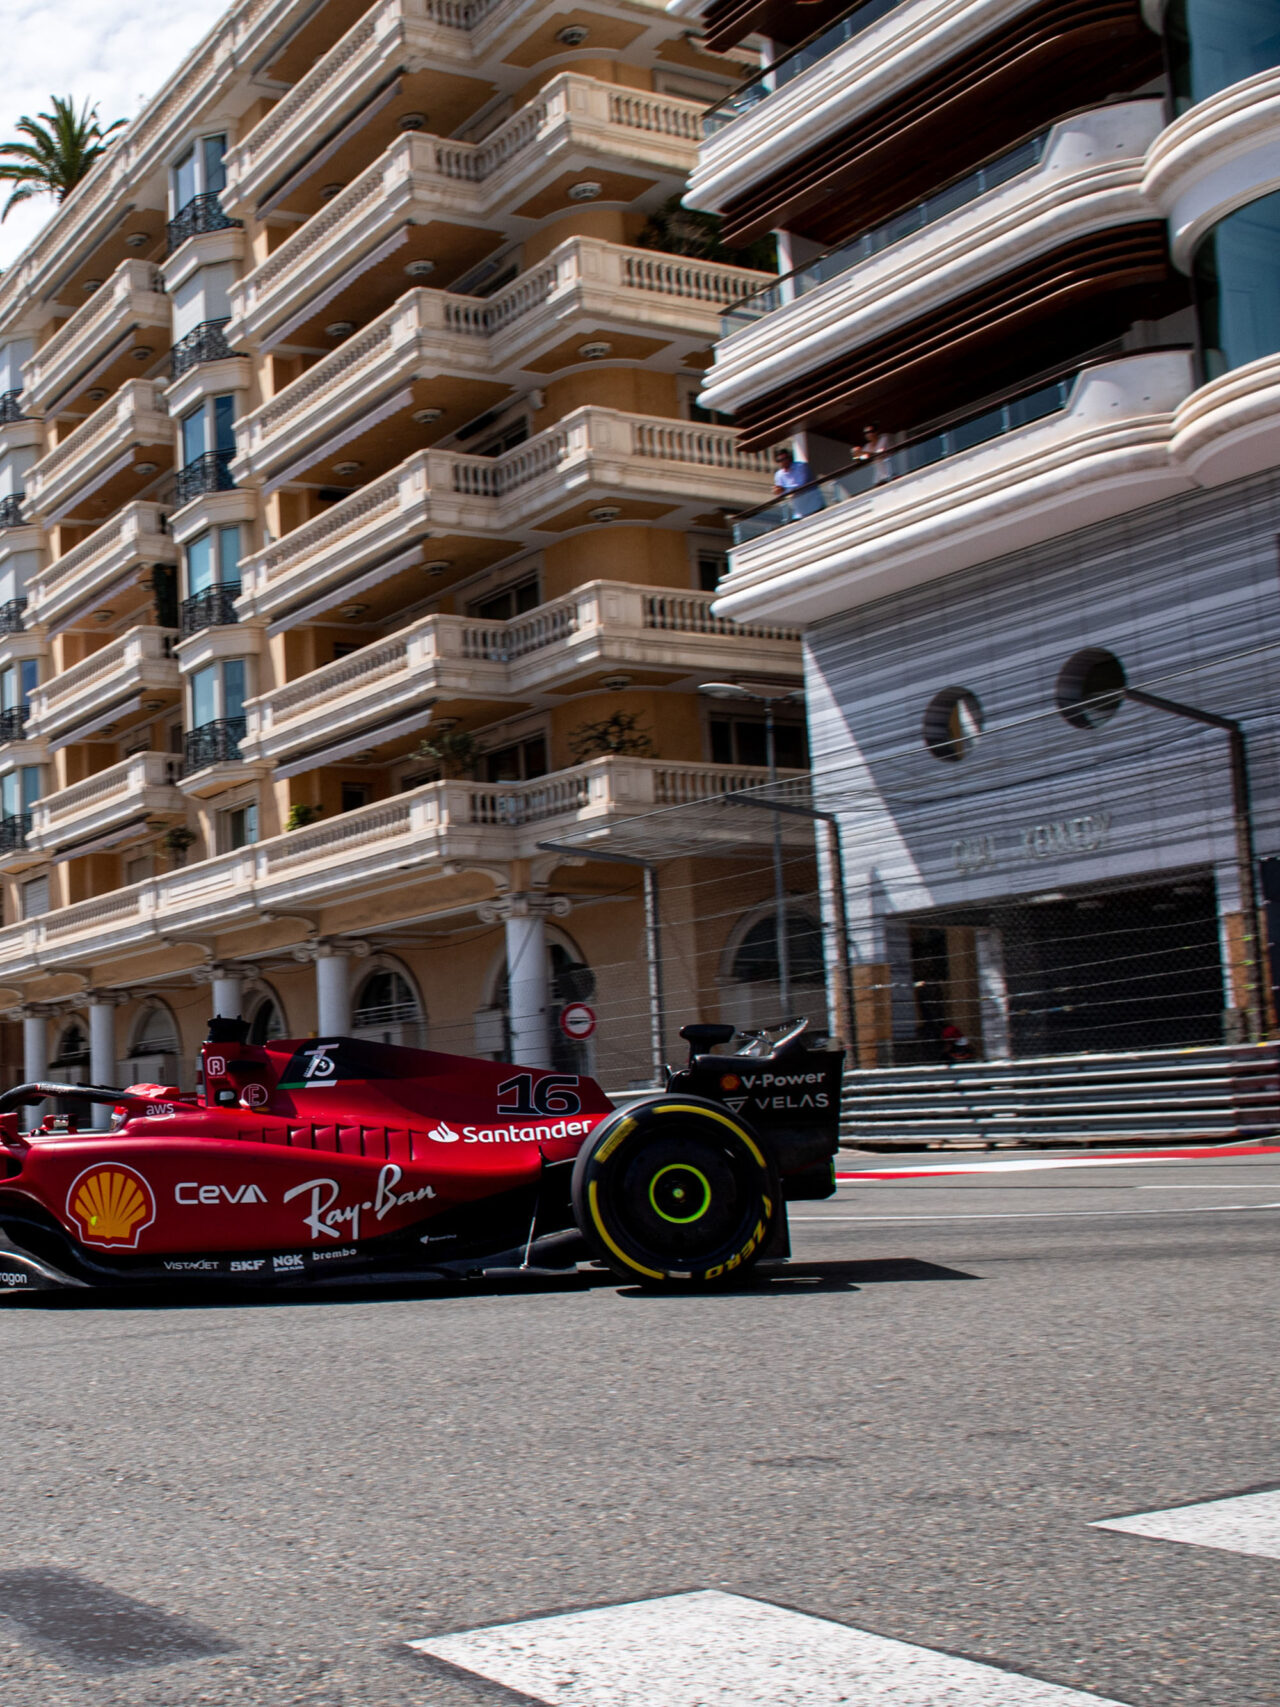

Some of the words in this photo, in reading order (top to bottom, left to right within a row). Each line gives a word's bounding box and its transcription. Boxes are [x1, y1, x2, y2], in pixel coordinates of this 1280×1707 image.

[741, 1072, 827, 1090] V-Power
[497, 1073, 582, 1117] 16
[146, 1103, 175, 1118] aws
[462, 1120, 593, 1144] Santander
[283, 1163, 437, 1240] Ray-Ban
[272, 1254, 305, 1267] NGK
[312, 1248, 358, 1261] brembo
[230, 1259, 266, 1272] SKF
